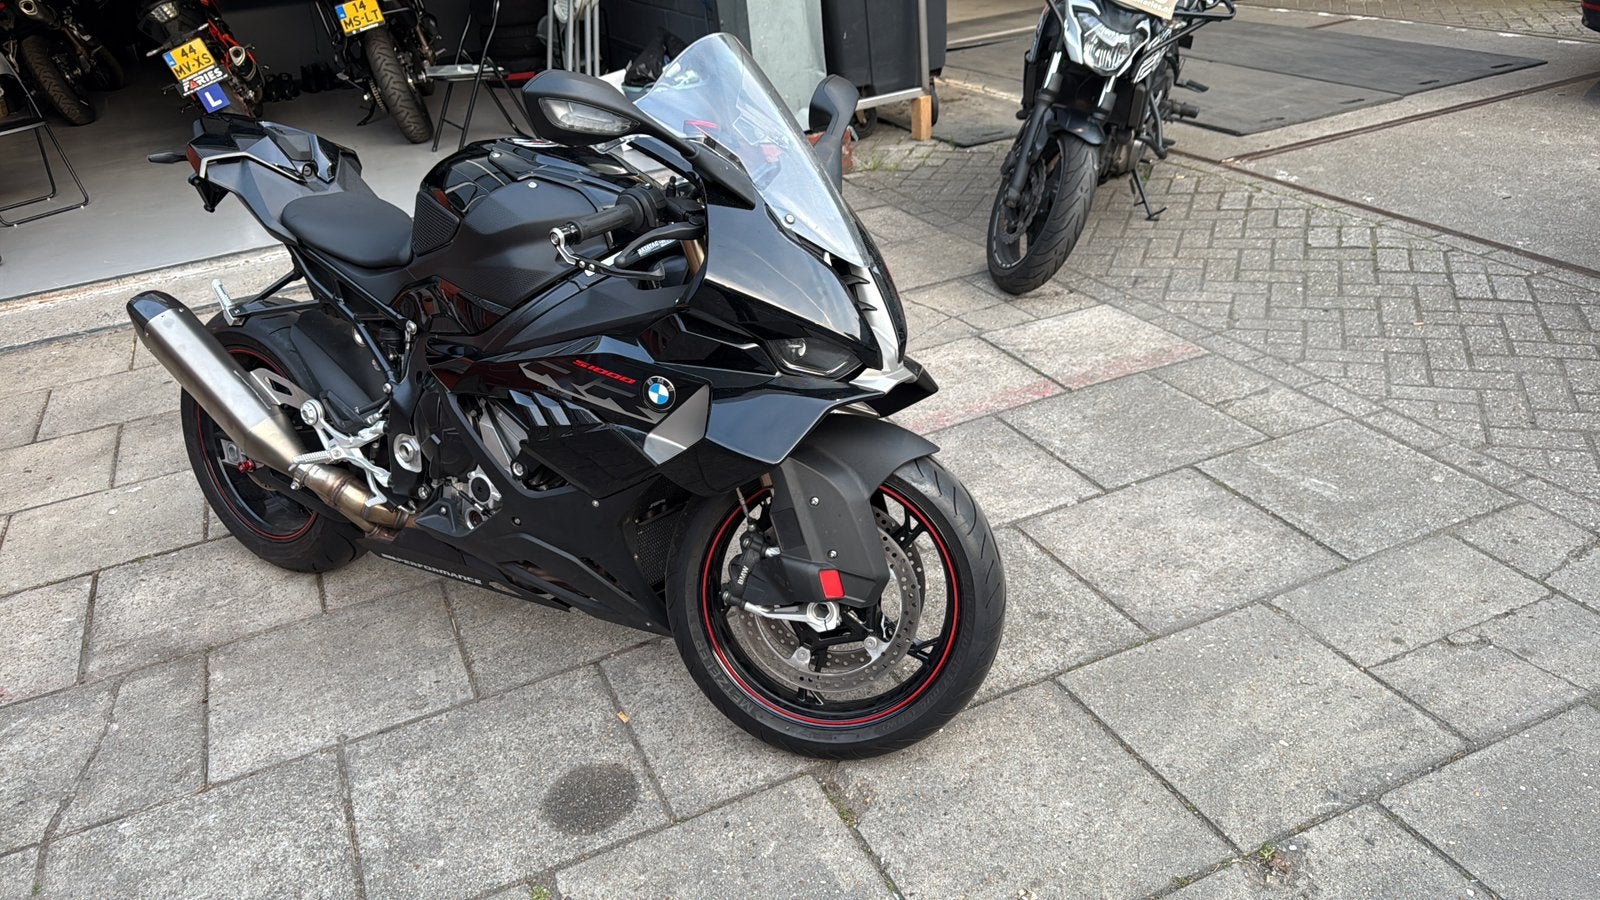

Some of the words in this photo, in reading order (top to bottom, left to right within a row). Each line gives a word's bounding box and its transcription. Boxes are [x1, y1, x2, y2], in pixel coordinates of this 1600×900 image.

[352, 1, 367, 13] 14
[343, 9, 379, 30] MS-LT
[181, 44, 197, 58] 44
[173, 53, 212, 78] MV-XS
[182, 67, 223, 92] FARIES
[204, 91, 223, 108] L
[572, 359, 637, 385] S1000
[736, 565, 749, 586] BMW
